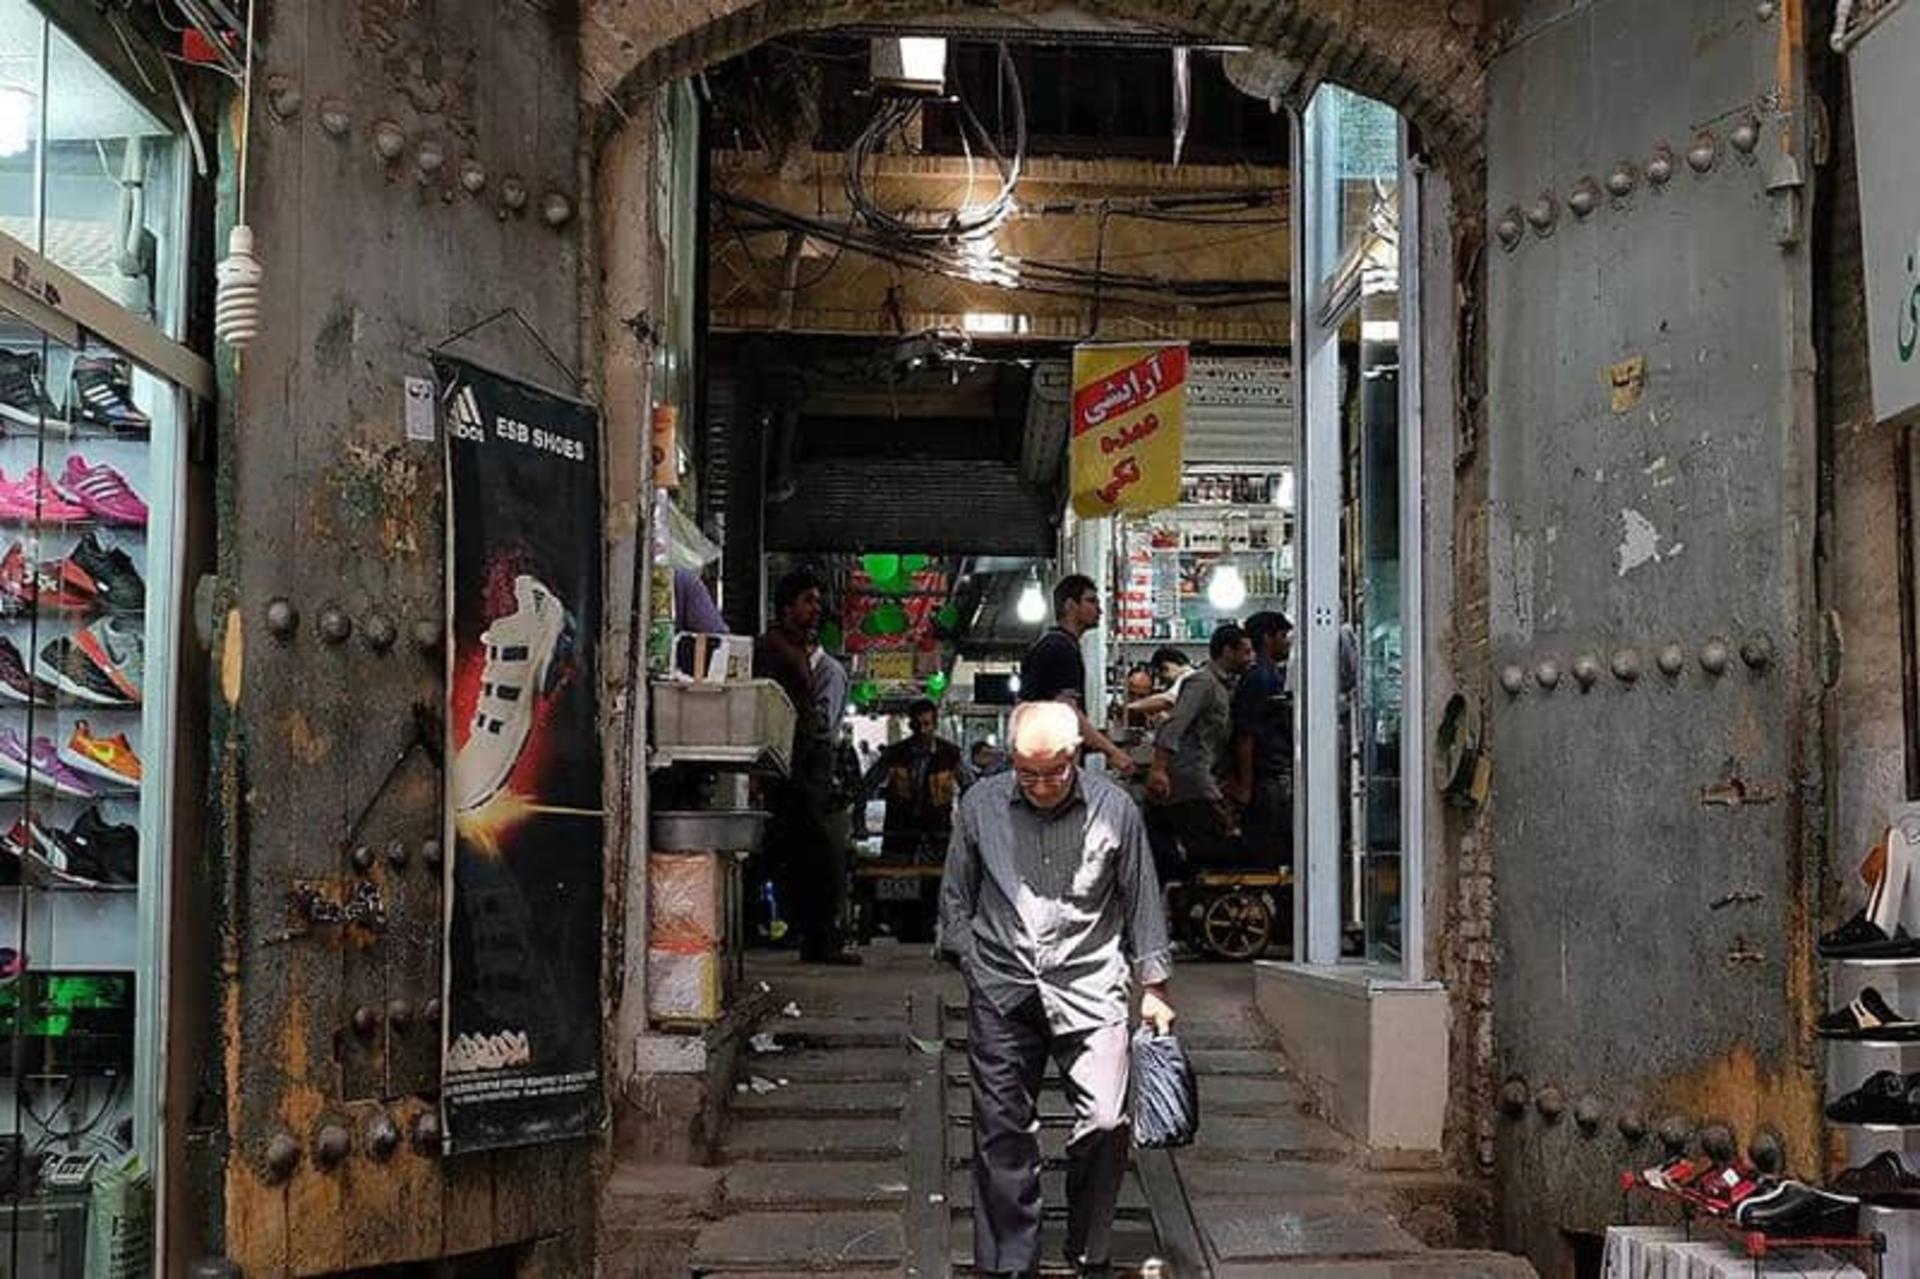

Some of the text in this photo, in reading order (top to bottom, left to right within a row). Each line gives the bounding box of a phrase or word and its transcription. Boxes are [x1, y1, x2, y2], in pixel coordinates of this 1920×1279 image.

[1084, 355, 1163, 424] آرایشی
[496, 416, 529, 443] ESB
[532, 429, 585, 461] SHOES
